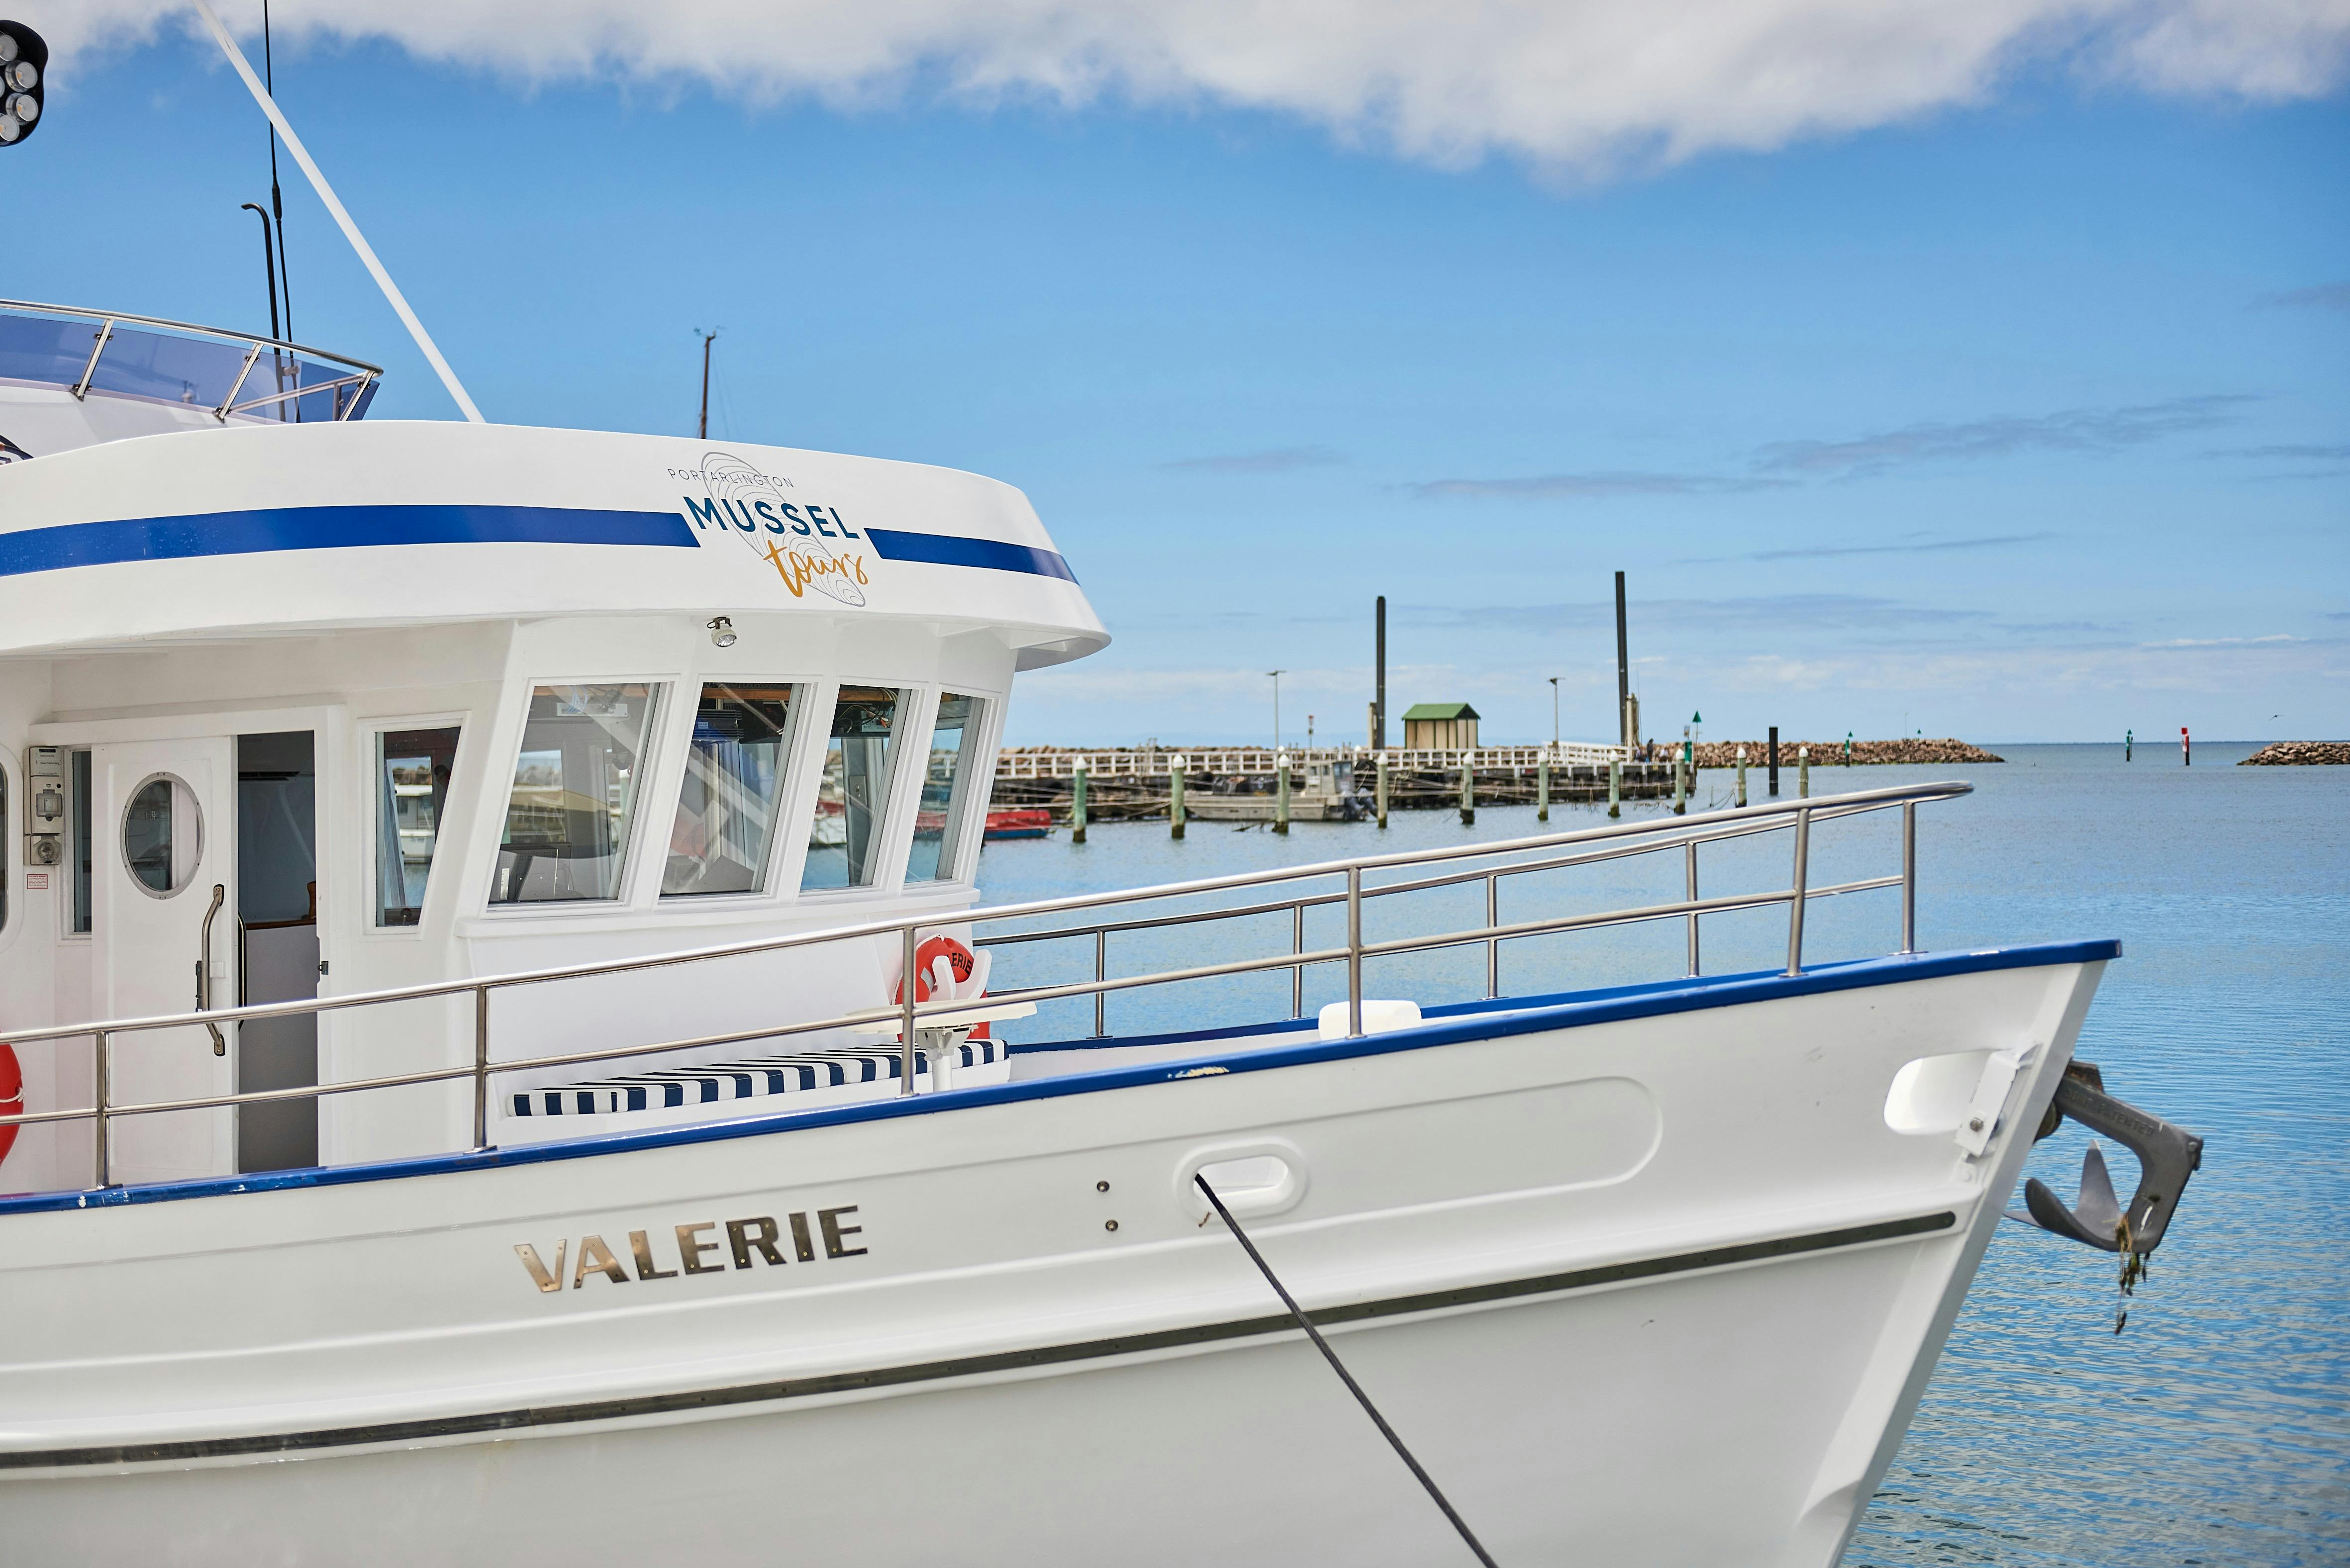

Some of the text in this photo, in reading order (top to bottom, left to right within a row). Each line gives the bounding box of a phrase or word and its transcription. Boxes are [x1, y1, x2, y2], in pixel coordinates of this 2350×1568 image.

[667, 468, 794, 488] PORTARLINGTON
[683, 496, 860, 539] MUSSEL
[763, 540, 869, 598] tours
[947, 952, 972, 975] ERIE
[513, 1205, 868, 1293] VALERIE
